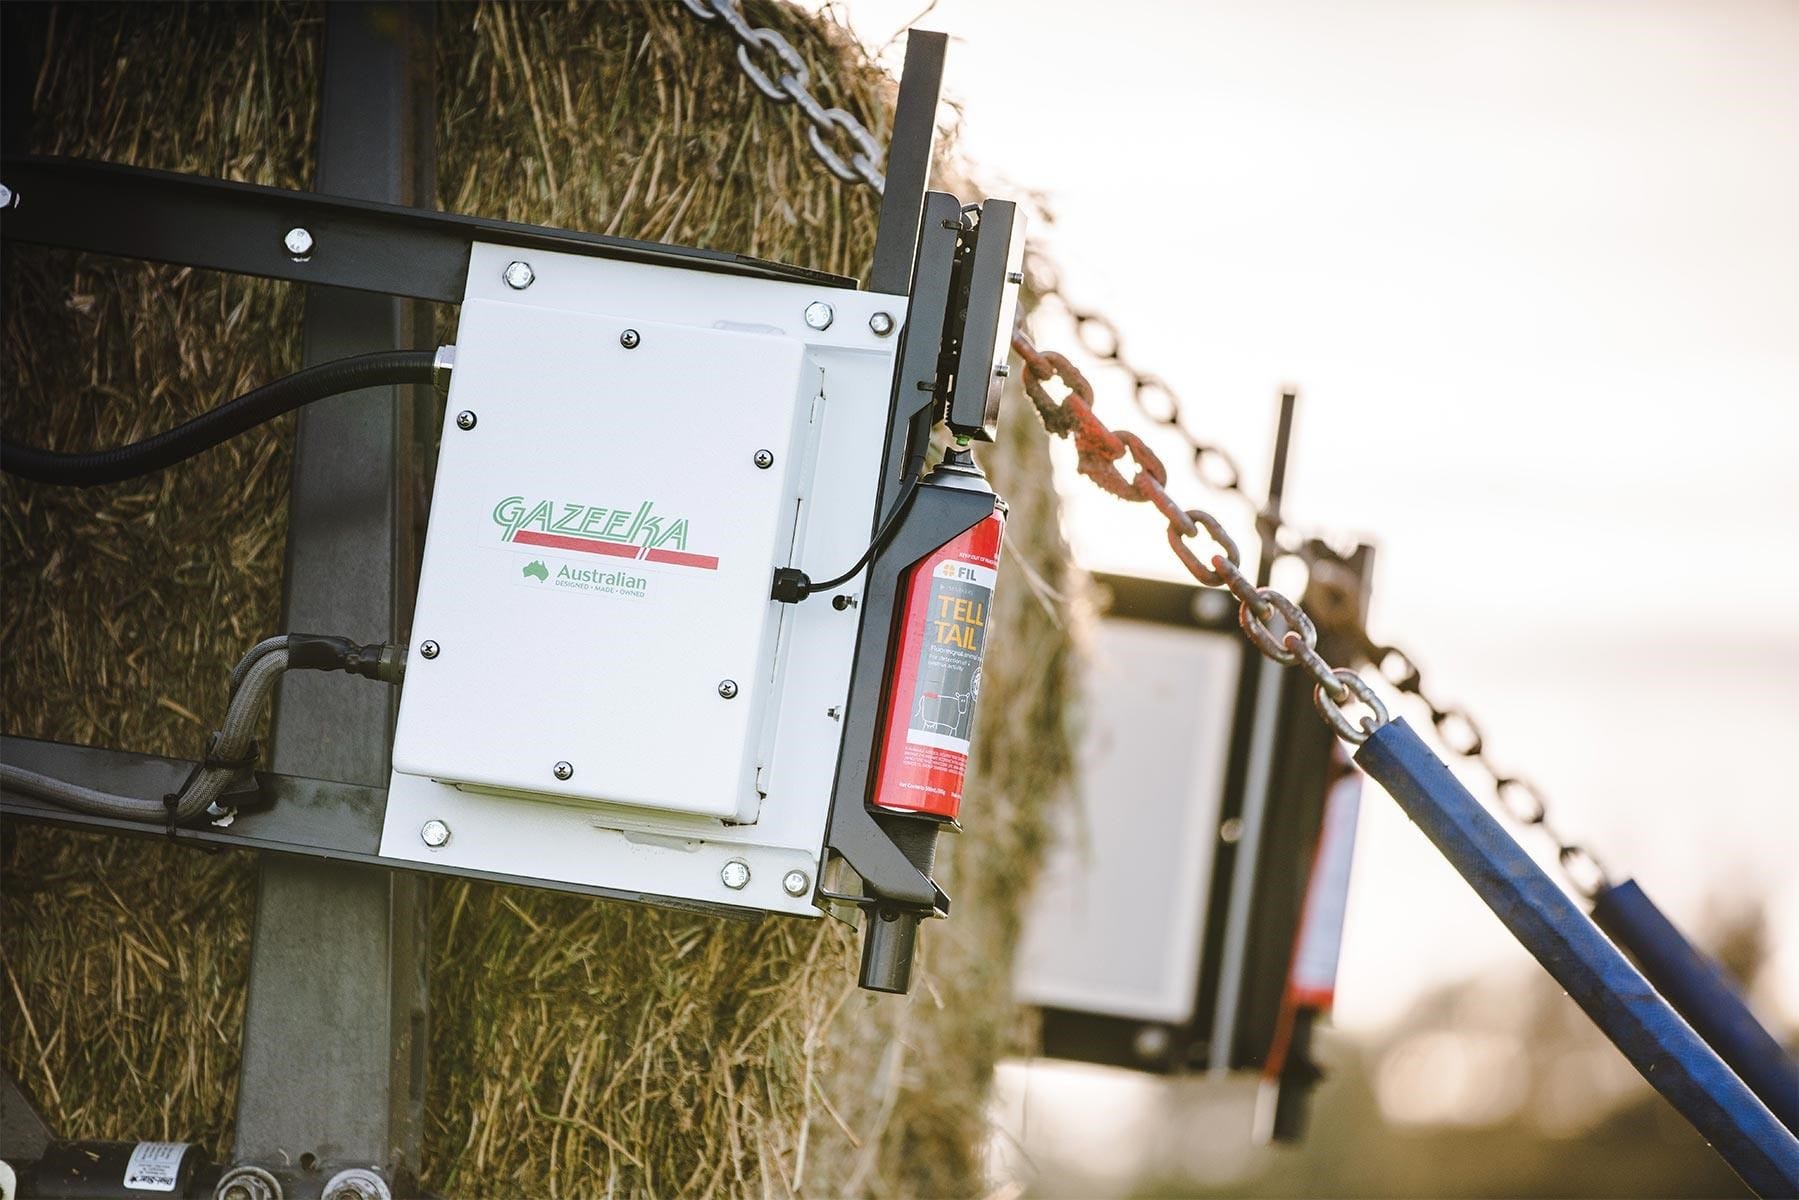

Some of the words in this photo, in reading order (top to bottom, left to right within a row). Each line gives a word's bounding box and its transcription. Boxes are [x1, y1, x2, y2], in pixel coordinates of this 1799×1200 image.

[492, 496, 689, 550] GAZEEKA
[555, 579, 589, 590] DESIGNED
[594, 585, 614, 594] MADE
[620, 589, 645, 598] OWNED
[557, 564, 647, 590] Australian
[958, 567, 977, 582] FIL
[938, 594, 984, 627] TELL
[934, 621, 977, 651] TAIL
